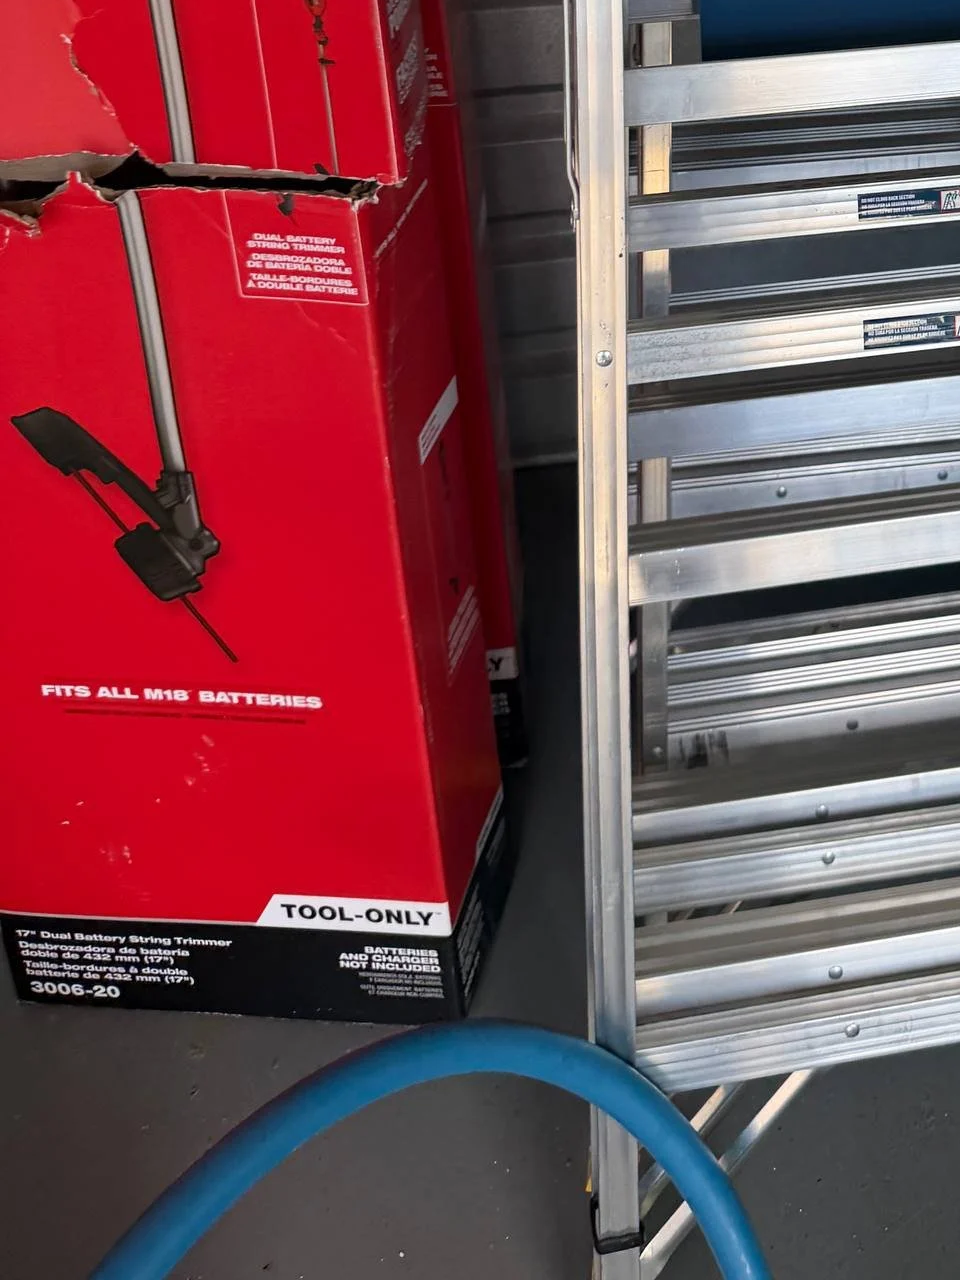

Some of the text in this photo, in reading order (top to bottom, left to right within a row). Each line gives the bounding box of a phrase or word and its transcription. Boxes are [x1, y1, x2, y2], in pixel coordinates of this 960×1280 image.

[252, 232, 336, 246] DUAL BATTERY
[246, 240, 346, 254] STRING TRIMMER
[251, 252, 346, 266] DESBROZADORA
[246, 260, 352, 275] DE DOBLE
[256, 281, 358, 296] DOUBLE BATTERIE
[40, 683, 323, 710] FITS ALL M18 BATTERIES
[40, 930, 72, 940] Dual
[74, 932, 126, 944] Battery
[128, 935, 172, 946] String
[173, 936, 233, 947] Trimmer
[18, 940, 116, 954] Desbrozadora
[118, 946, 137, 955] de
[364, 945, 438, 957] BATTERIES
[20, 948, 141, 963] doble de 432 mm
[338, 952, 440, 965] AND CHARGER
[22, 960, 188, 976] Taille-bordures double
[339, 960, 441, 973] NOT INCLUDED
[26, 968, 161, 983] batterie de 432 mm
[29, 980, 121, 998] 3006-20
